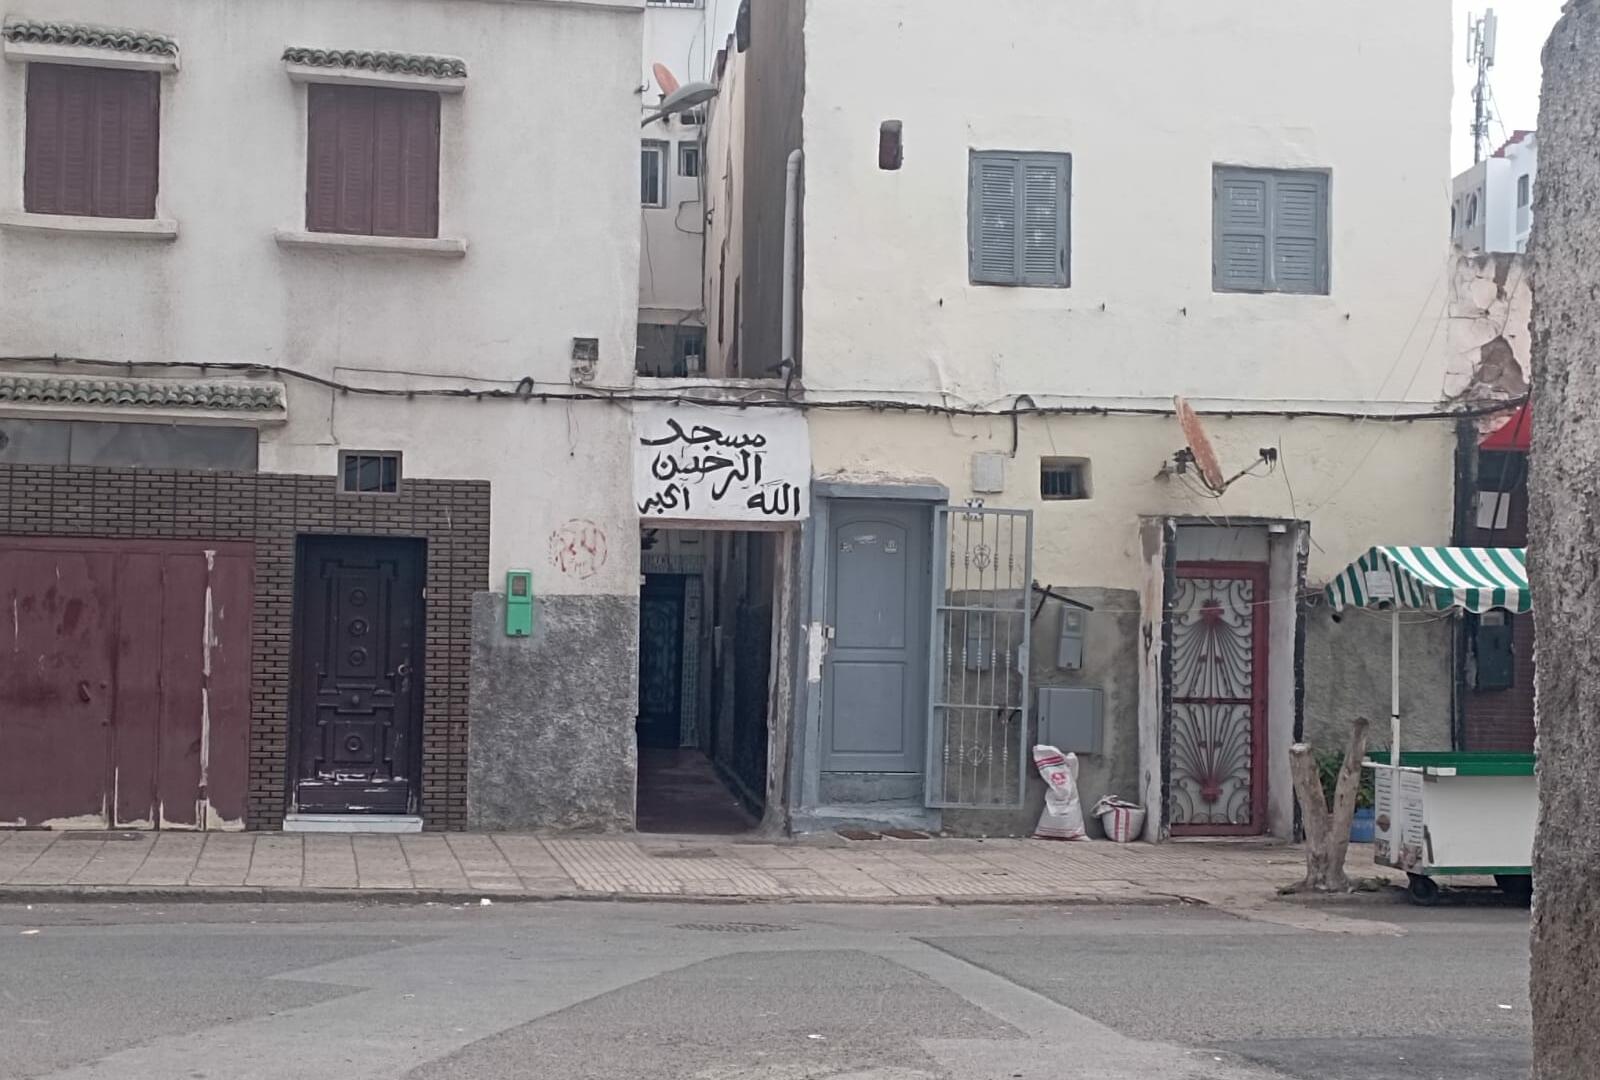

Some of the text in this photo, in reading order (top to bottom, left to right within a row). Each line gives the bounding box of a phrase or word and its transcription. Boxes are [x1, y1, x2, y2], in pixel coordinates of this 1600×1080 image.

[640, 418, 766, 452] مسجد
[652, 449, 761, 500] الرحمن
[747, 482, 800, 516] الله
